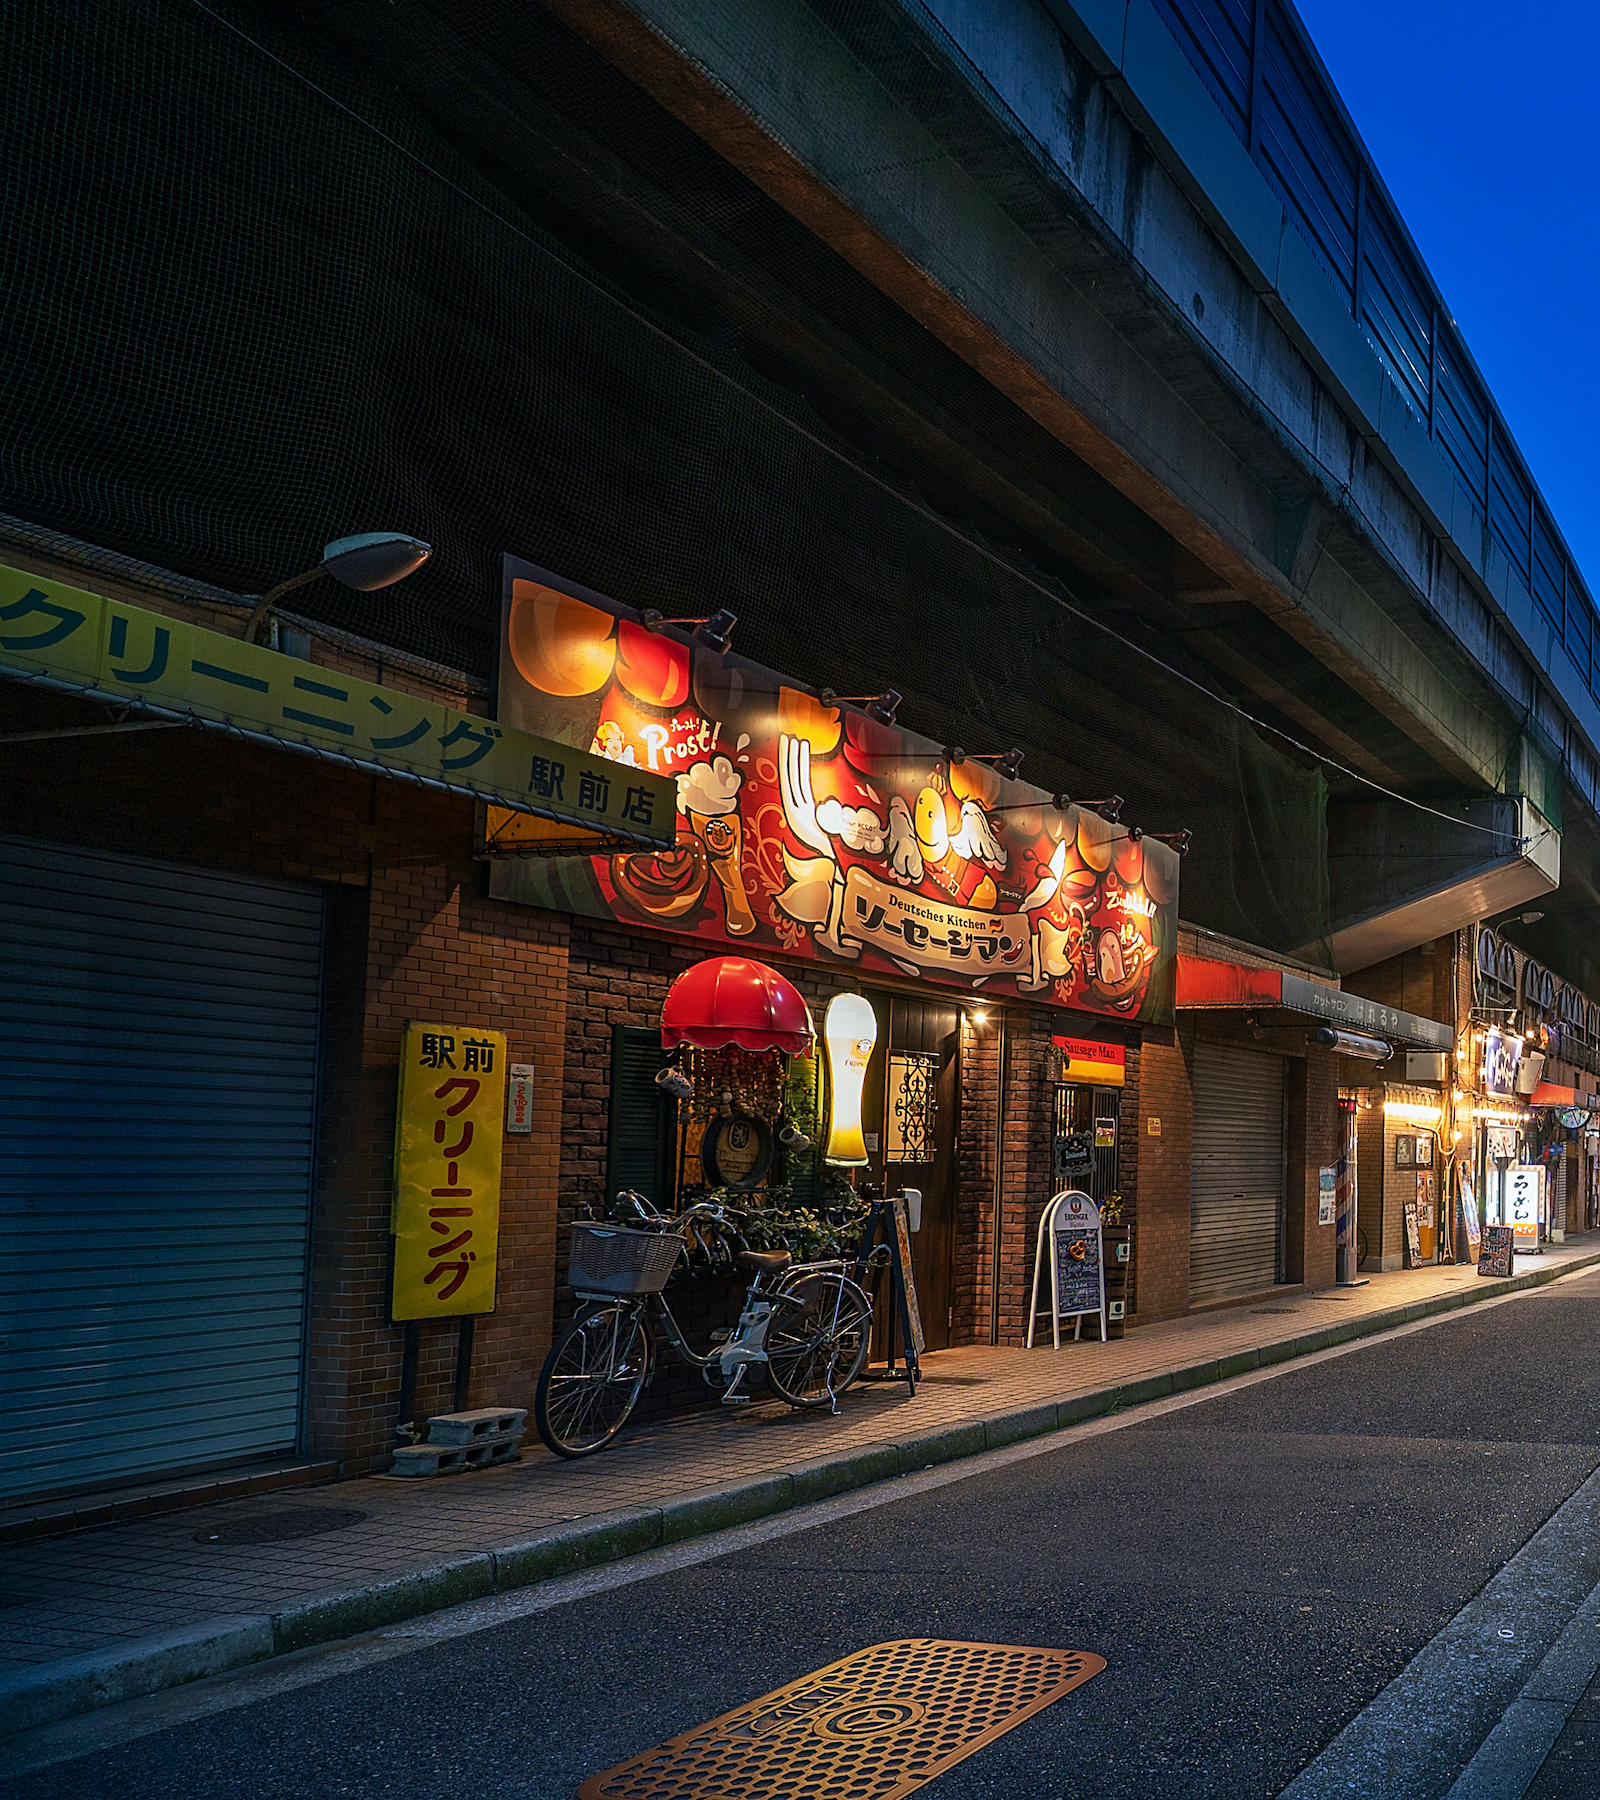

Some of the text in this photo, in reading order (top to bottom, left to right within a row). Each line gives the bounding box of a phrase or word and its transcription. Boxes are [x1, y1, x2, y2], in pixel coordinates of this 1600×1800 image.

[0, 587, 656, 826] クリーニング 駅前店
[639, 719, 722, 771] Prost!
[855, 894, 1026, 965] ソーセージマン
[888, 893, 987, 931] Deutsches Kitchen
[1313, 993, 1349, 1012] カットサロン
[1356, 1001, 1398, 1030] はれるや
[419, 1031, 498, 1073] 駅前
[1064, 1040, 1115, 1059] Sausage Man
[423, 1077, 482, 1301] クリーニング
[1513, 1174, 1530, 1220] らーめん
[1065, 1213, 1089, 1222] ERDINGER
